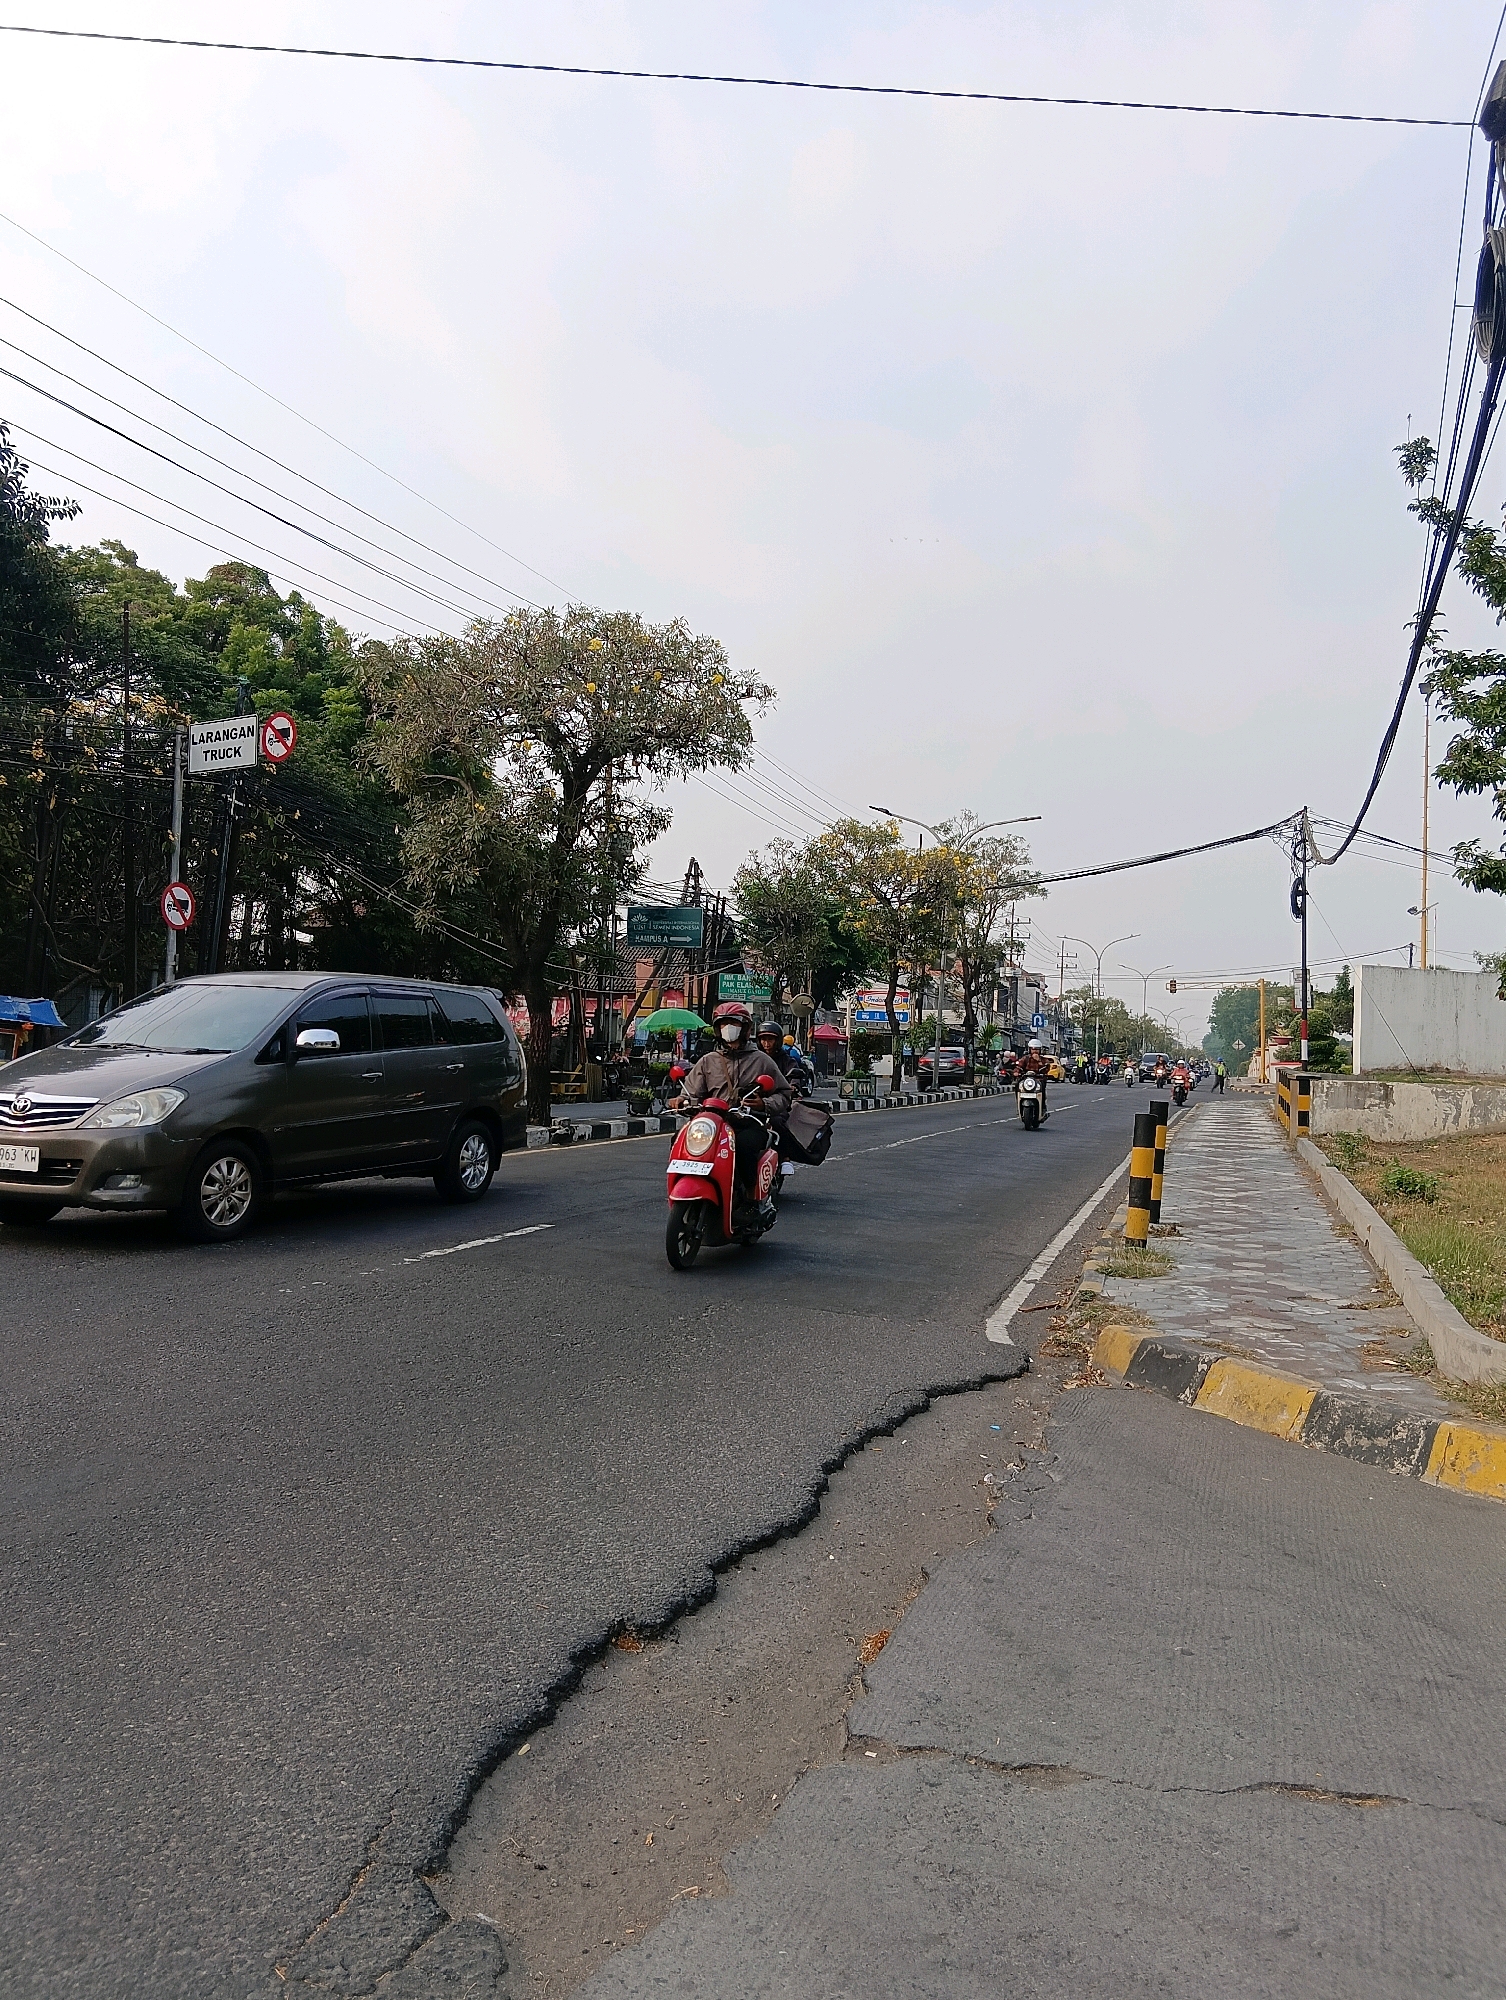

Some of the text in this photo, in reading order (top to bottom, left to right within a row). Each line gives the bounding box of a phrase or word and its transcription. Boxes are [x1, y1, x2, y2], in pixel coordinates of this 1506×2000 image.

[191, 725, 255, 746] LARANGAN
[203, 746, 242, 762] TRUCK
[662, 935, 669, 943] A
[865, 995, 900, 1004] Indoet
[24, 1149, 37, 1162] KW
